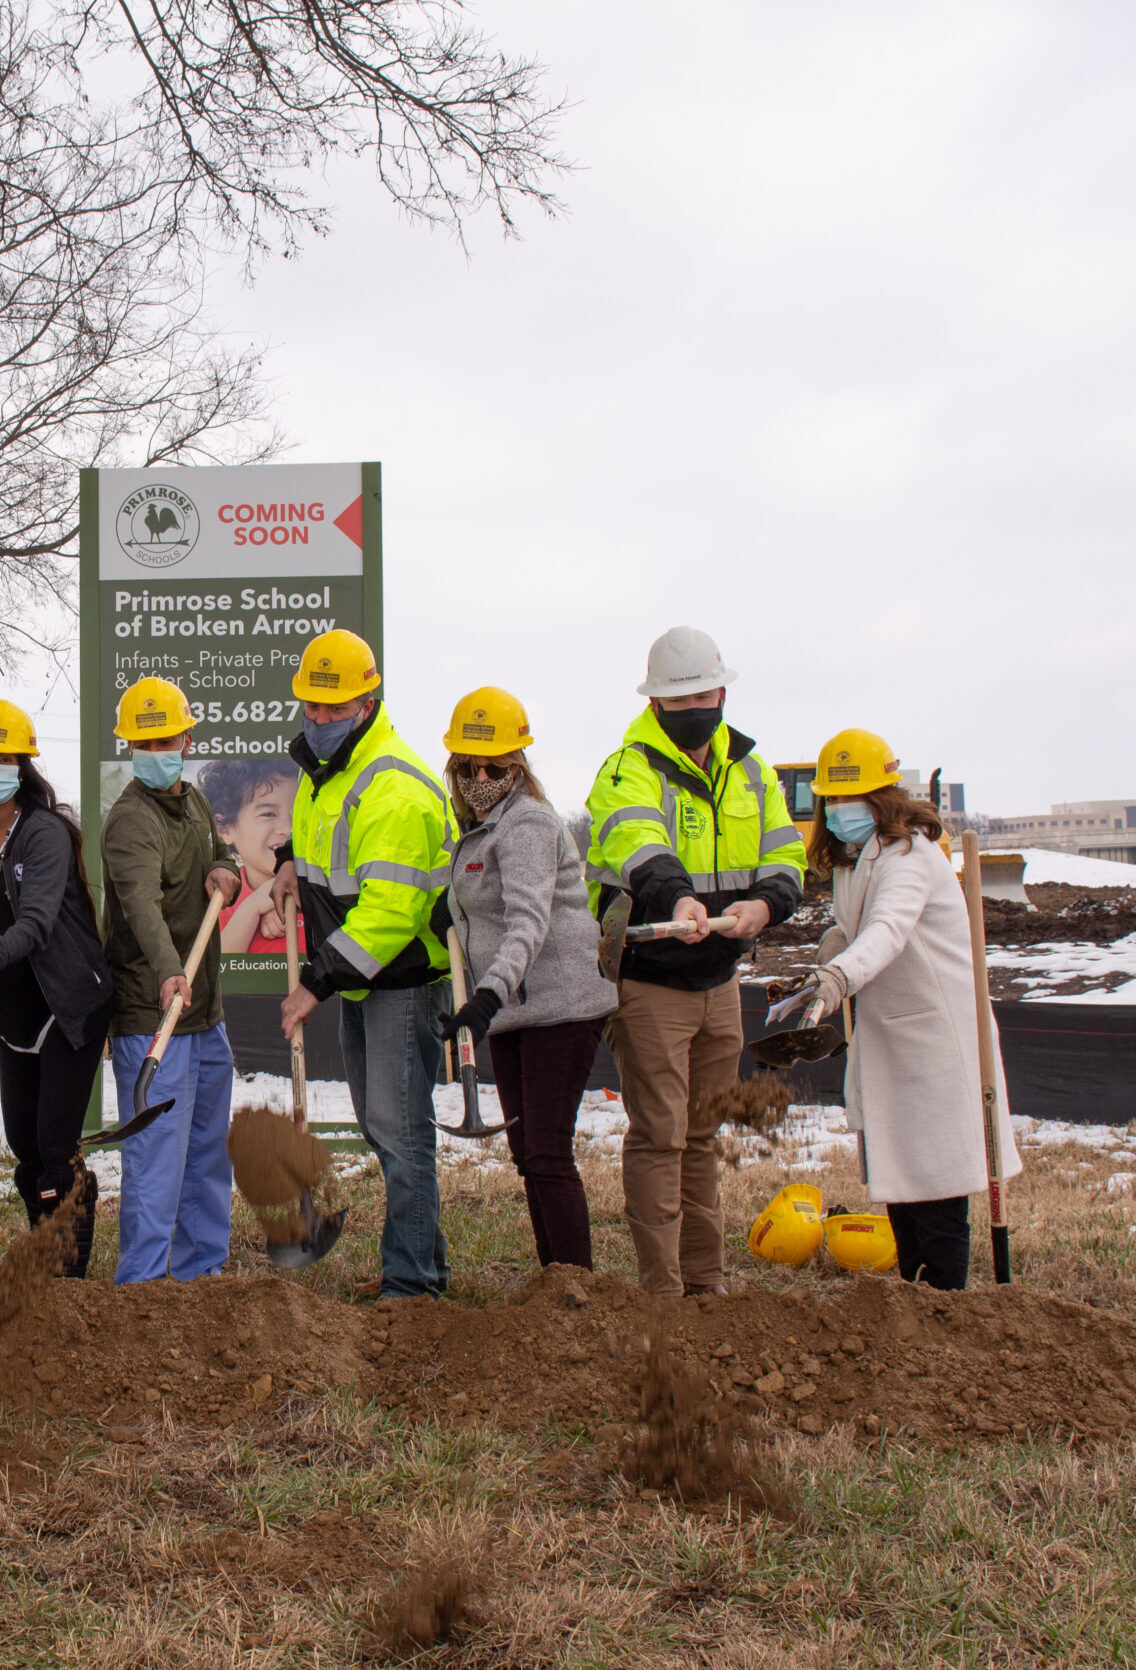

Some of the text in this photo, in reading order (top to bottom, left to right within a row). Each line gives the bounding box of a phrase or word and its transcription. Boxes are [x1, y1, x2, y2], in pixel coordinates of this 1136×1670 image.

[122, 487, 193, 516] PRIMROSE
[217, 502, 325, 523] COMING
[233, 526, 309, 546] SOON
[135, 550, 181, 564] SCHOOLS
[115, 586, 331, 612] Primrose School
[114, 614, 336, 638] of Broken Arrow
[115, 650, 179, 669] Infants
[199, 650, 264, 668] Private
[270, 649, 300, 667] Pre
[115, 672, 130, 689] &
[189, 669, 256, 688] School
[230, 959, 288, 971] Education
